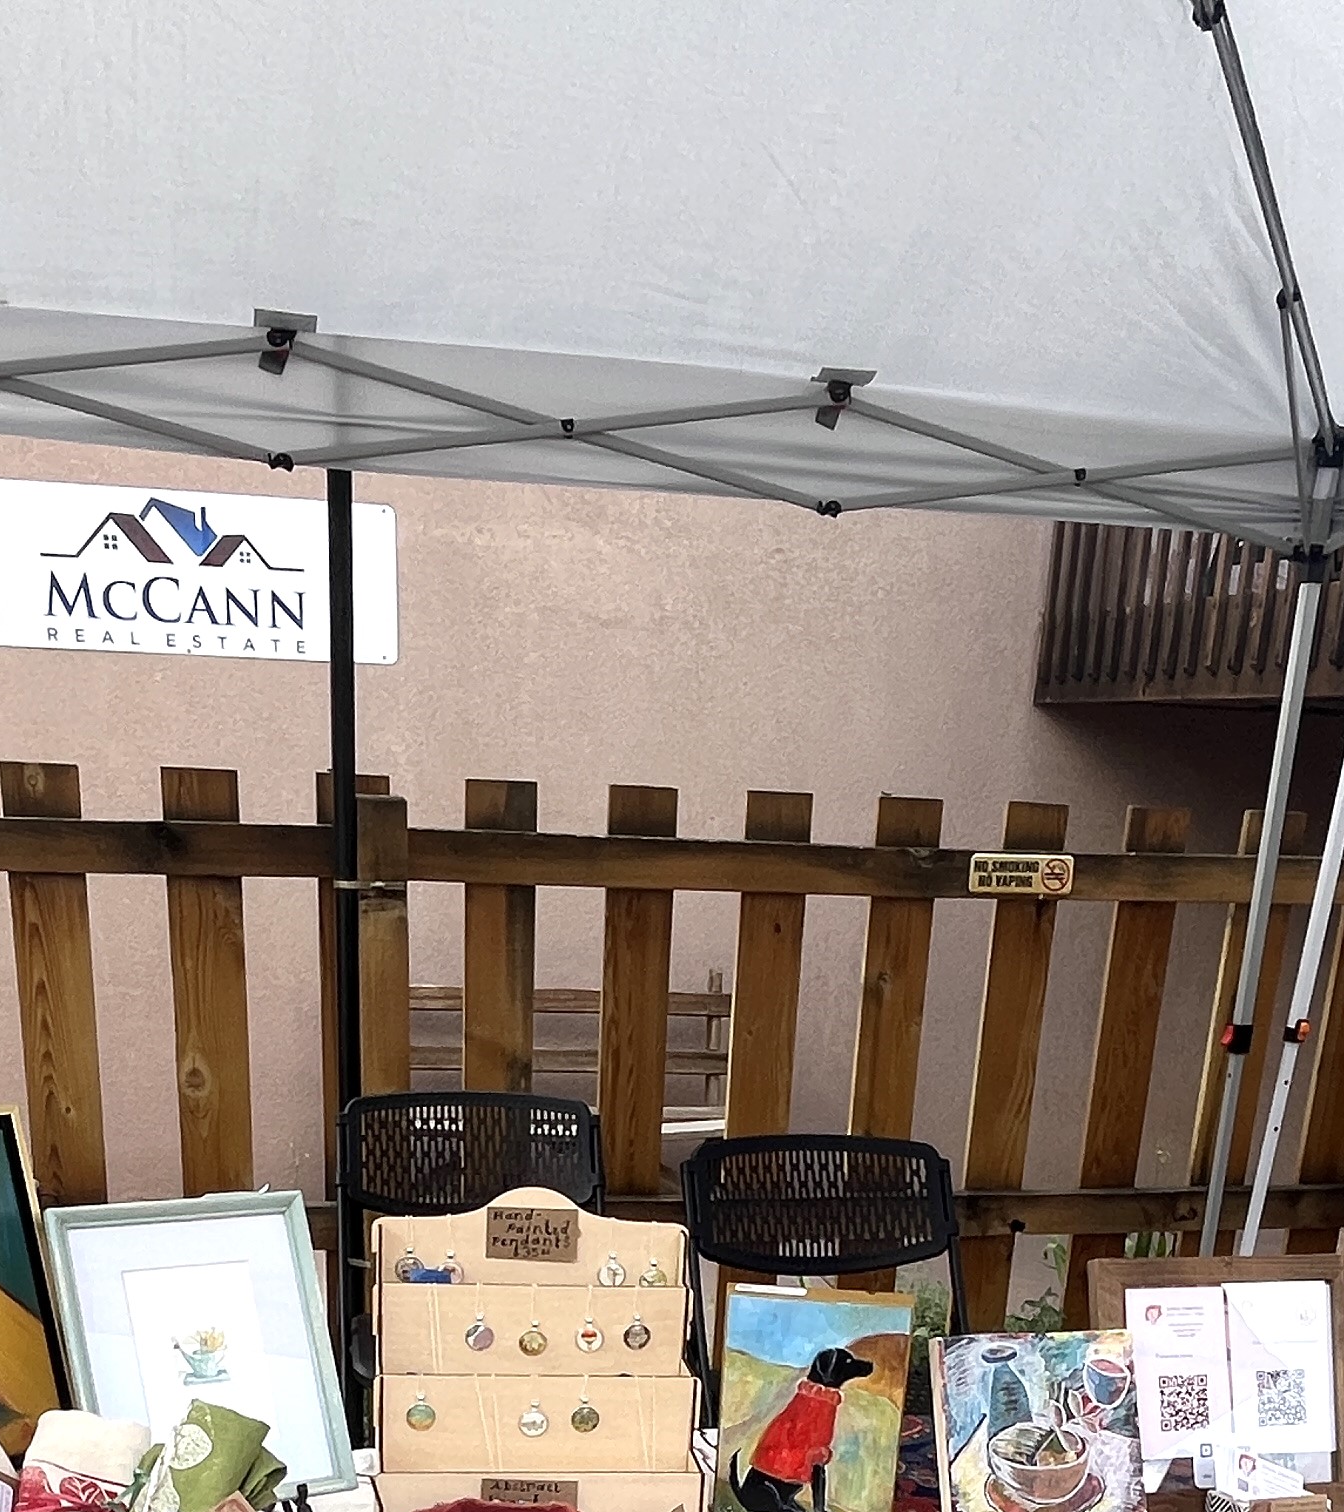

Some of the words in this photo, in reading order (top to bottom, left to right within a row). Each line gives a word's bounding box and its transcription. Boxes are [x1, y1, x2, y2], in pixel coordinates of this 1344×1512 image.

[46, 627, 141, 647] REAL
[166, 633, 307, 655] ESTATE
[974, 860, 988, 873] NO
